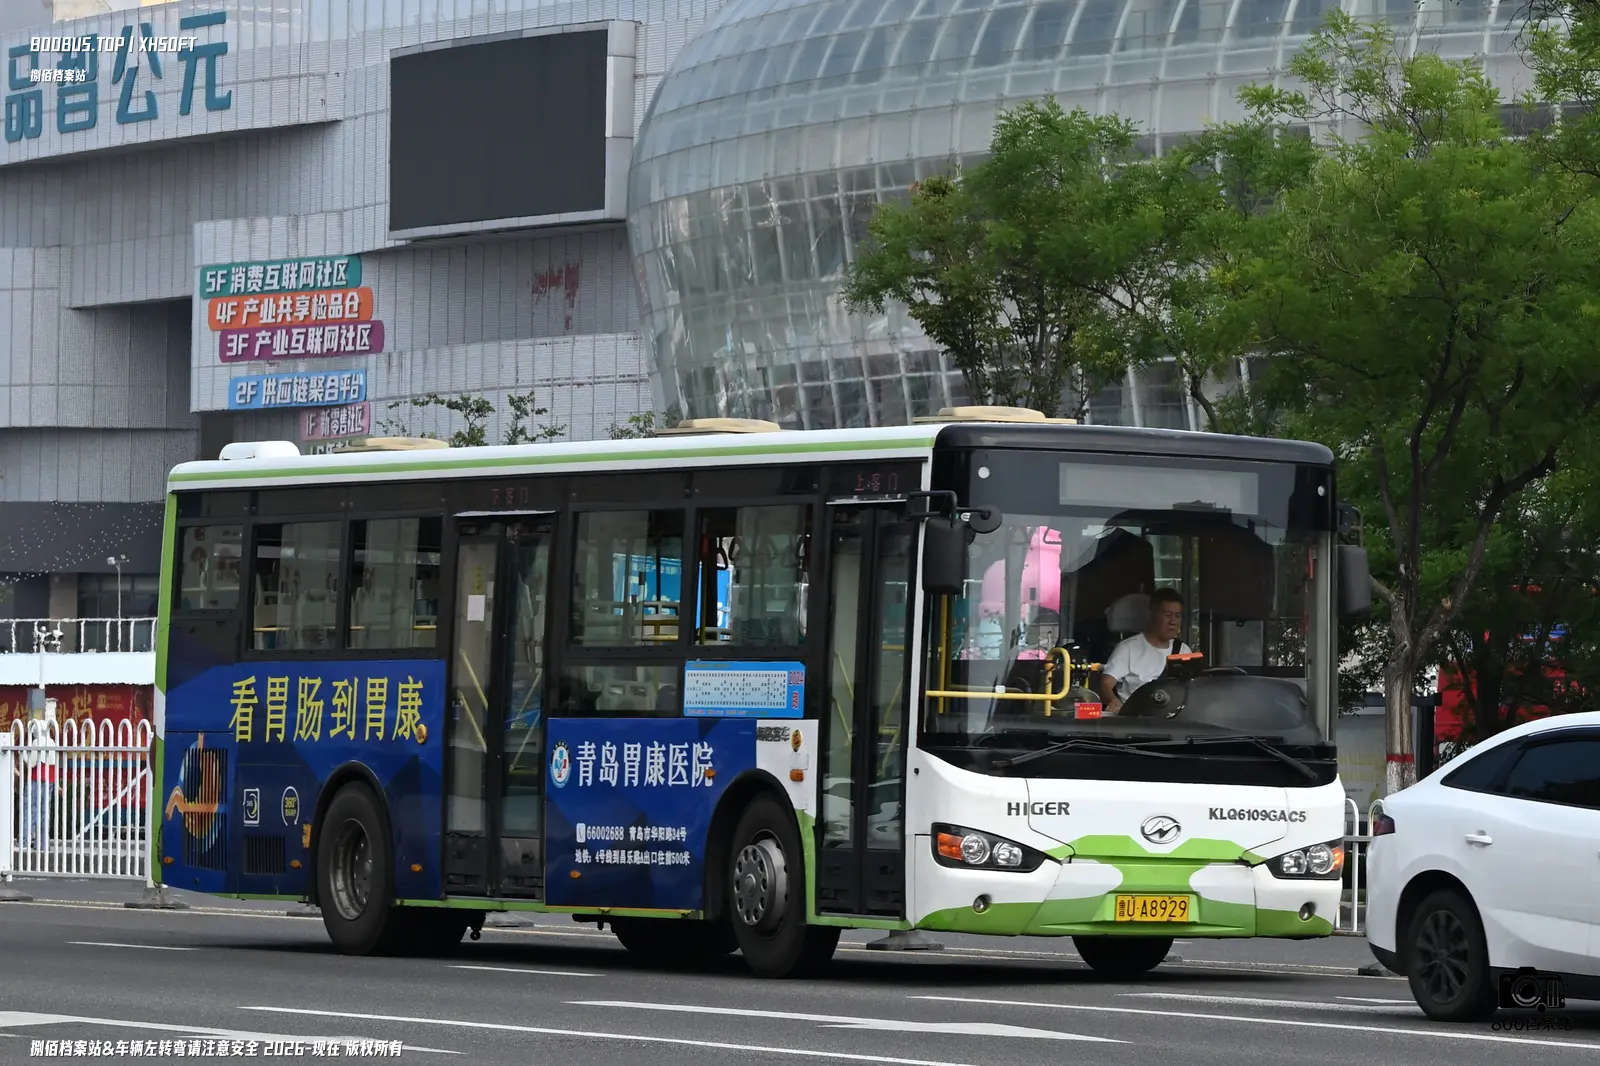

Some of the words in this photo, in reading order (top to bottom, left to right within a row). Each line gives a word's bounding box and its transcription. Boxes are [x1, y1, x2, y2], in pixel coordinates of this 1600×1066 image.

[205, 270, 227, 293] 5F
[230, 258, 348, 293] 消费互联网社区
[216, 301, 237, 324] 4F
[242, 291, 360, 325] 产业共享检品仓
[226, 333, 249, 356] 3F
[255, 324, 372, 357] 产业互联网社区
[236, 381, 257, 404] 2F
[262, 373, 363, 405] 供应链聚合平台
[320, 405, 363, 437] 新零售社区
[228, 675, 424, 743] 看胃肠到胃康
[576, 741, 714, 788] 青岛胃康医院
[1006, 802, 1071, 816] HIGER
[1208, 807, 1307, 823] KLQ6109GAC5
[586, 825, 625, 841] 66002688
